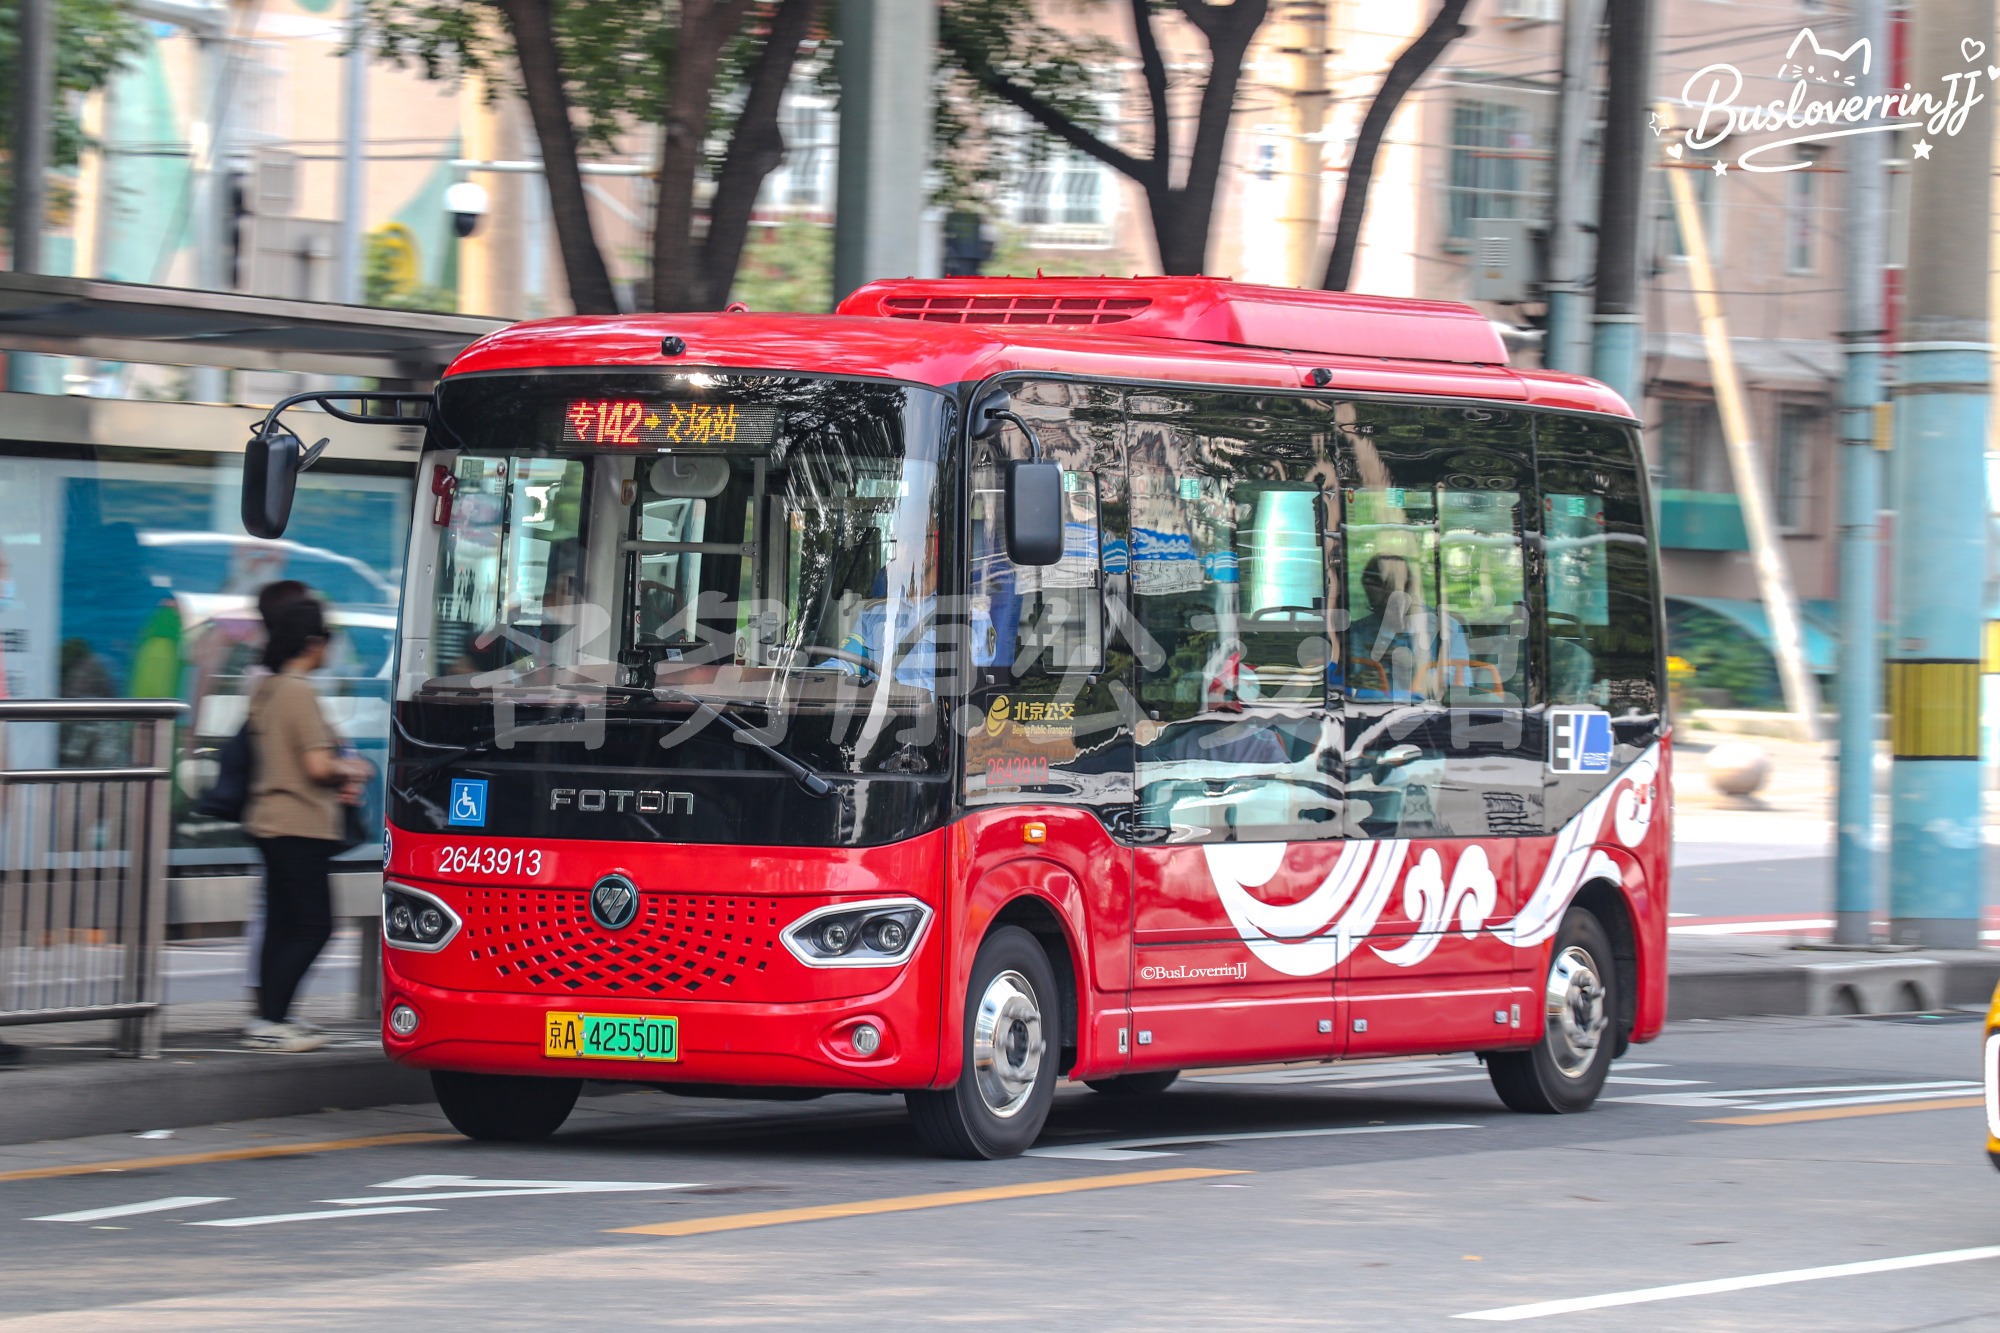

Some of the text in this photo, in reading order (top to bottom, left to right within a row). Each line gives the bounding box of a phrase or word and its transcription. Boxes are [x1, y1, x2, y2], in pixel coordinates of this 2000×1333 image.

[568, 401, 643, 444] 专142
[1013, 701, 1075, 721] 北京公交
[1012, 725, 1073, 737] Beijing Public Transport
[986, 756, 1048, 785] 2643913
[550, 788, 694, 815] FOTON
[438, 846, 542, 876] 2643913
[549, 1020, 674, 1054] 京A 42550D
